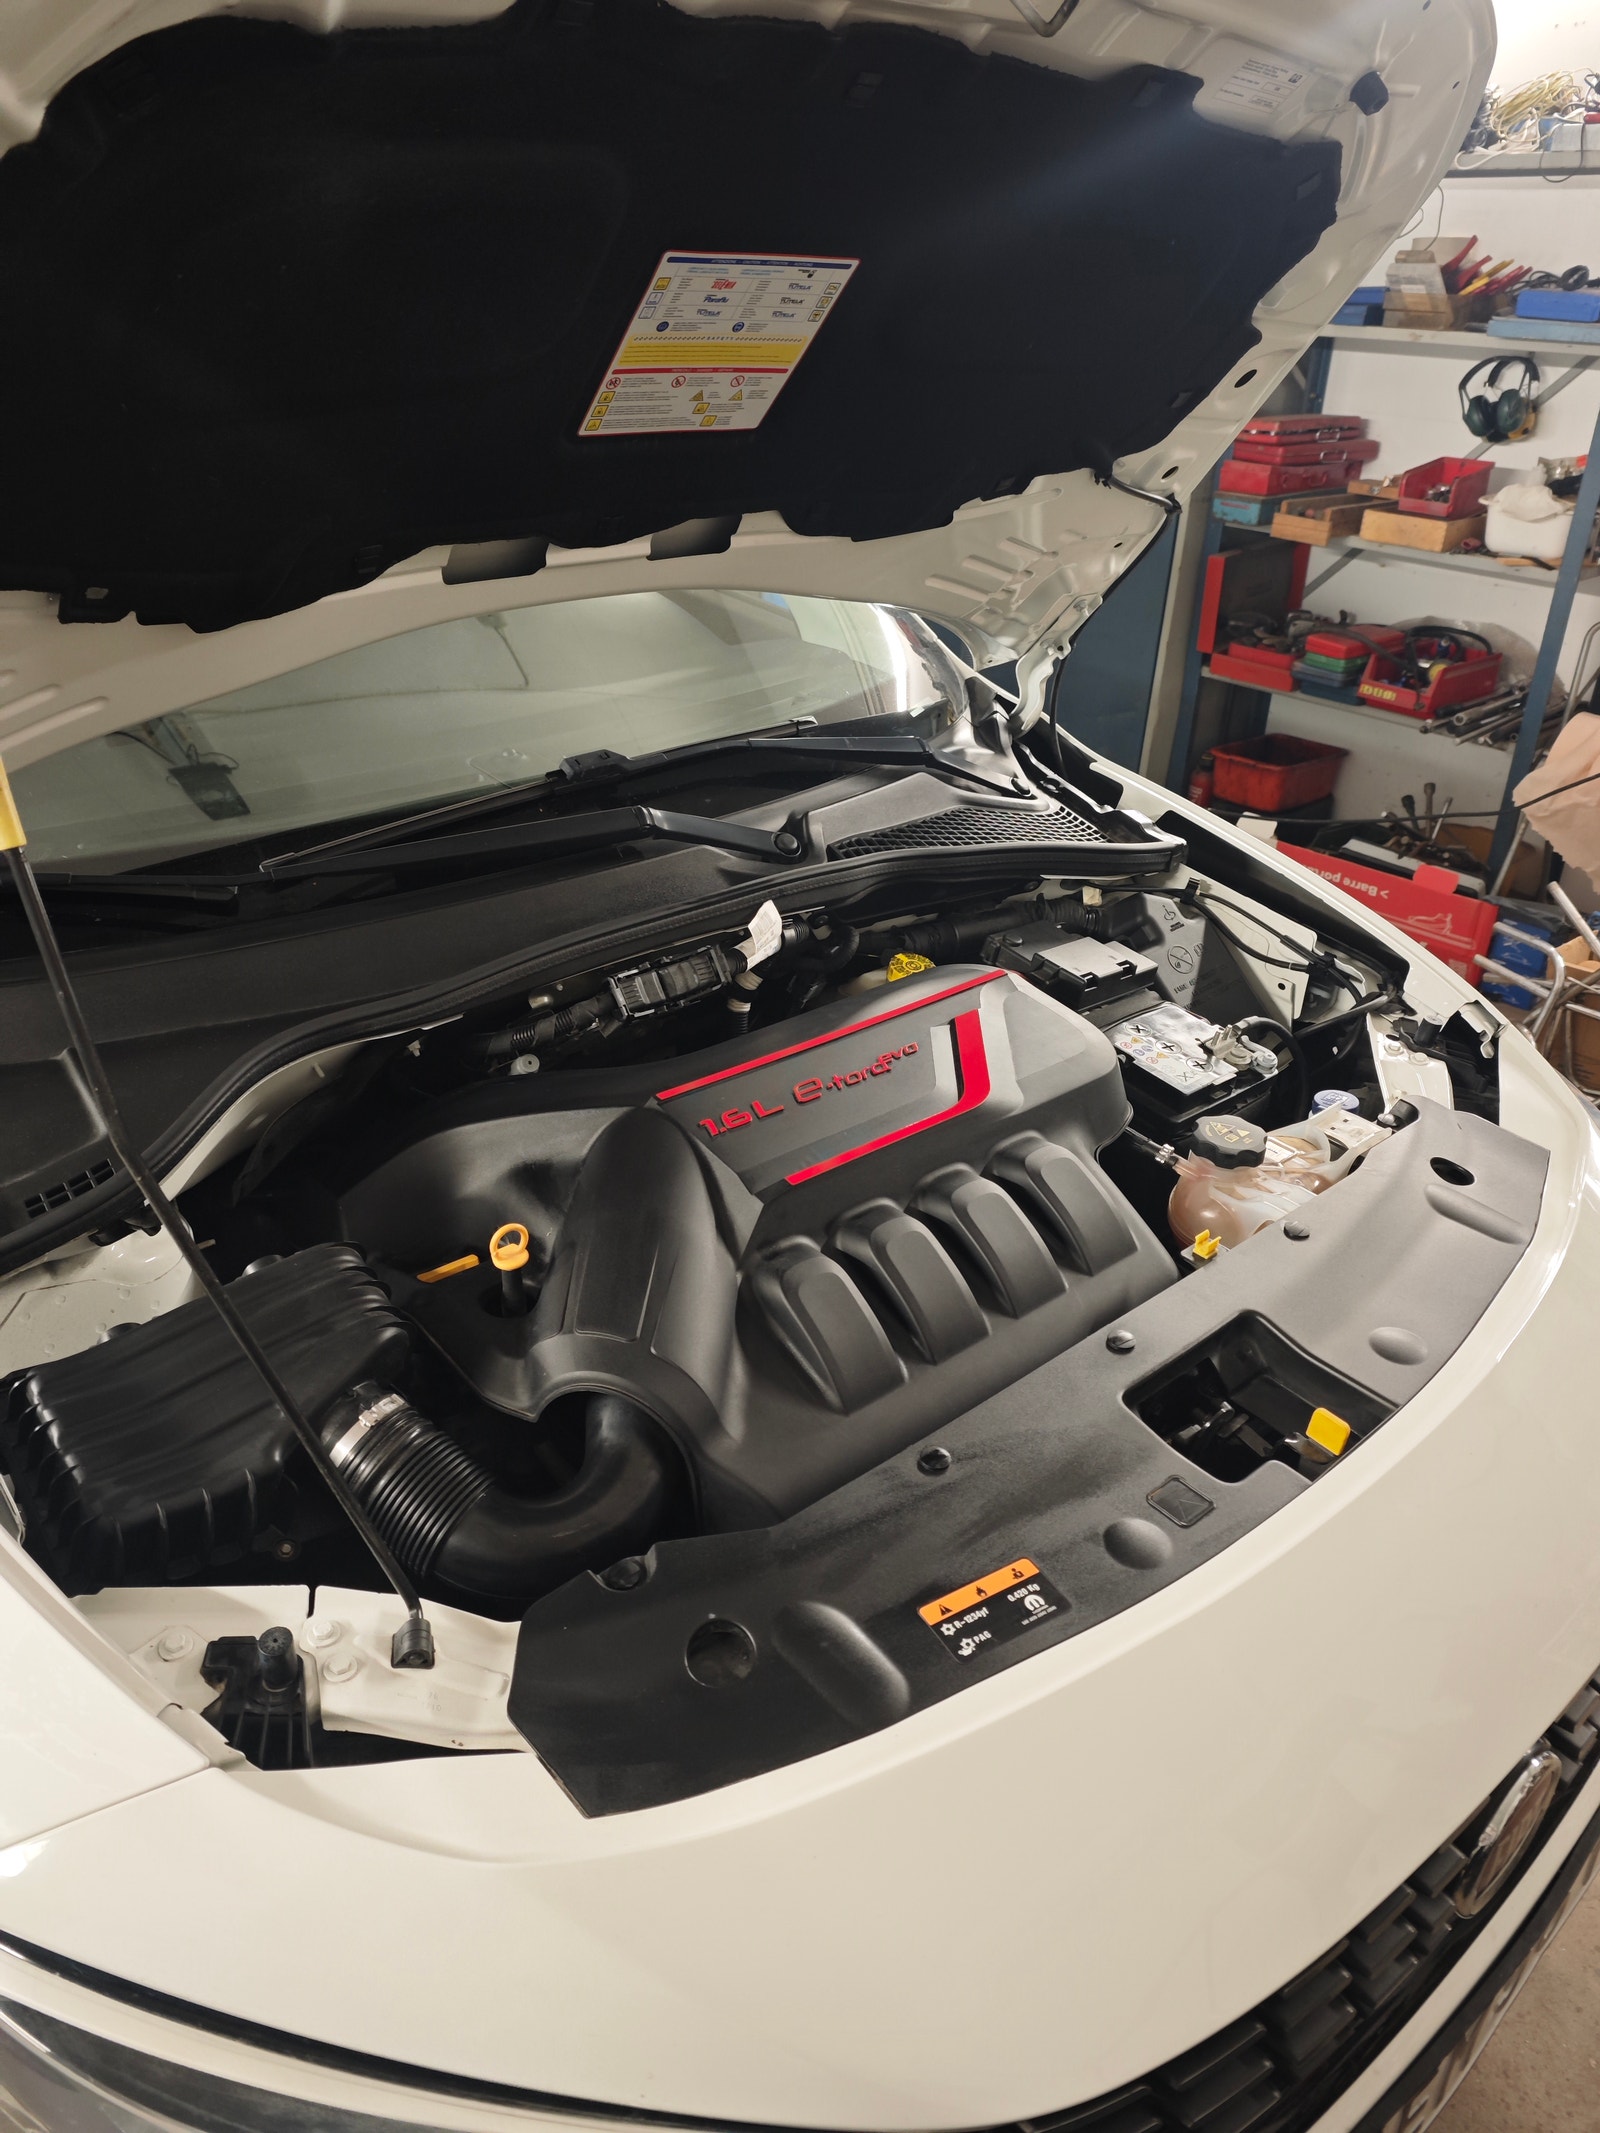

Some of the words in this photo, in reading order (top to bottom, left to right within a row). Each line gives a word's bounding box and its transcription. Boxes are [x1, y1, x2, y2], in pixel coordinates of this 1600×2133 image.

[1342, 877, 1378, 896] Barre
[954, 1607, 989, 1629] R-1234yf
[973, 1630, 992, 1645] PAG
